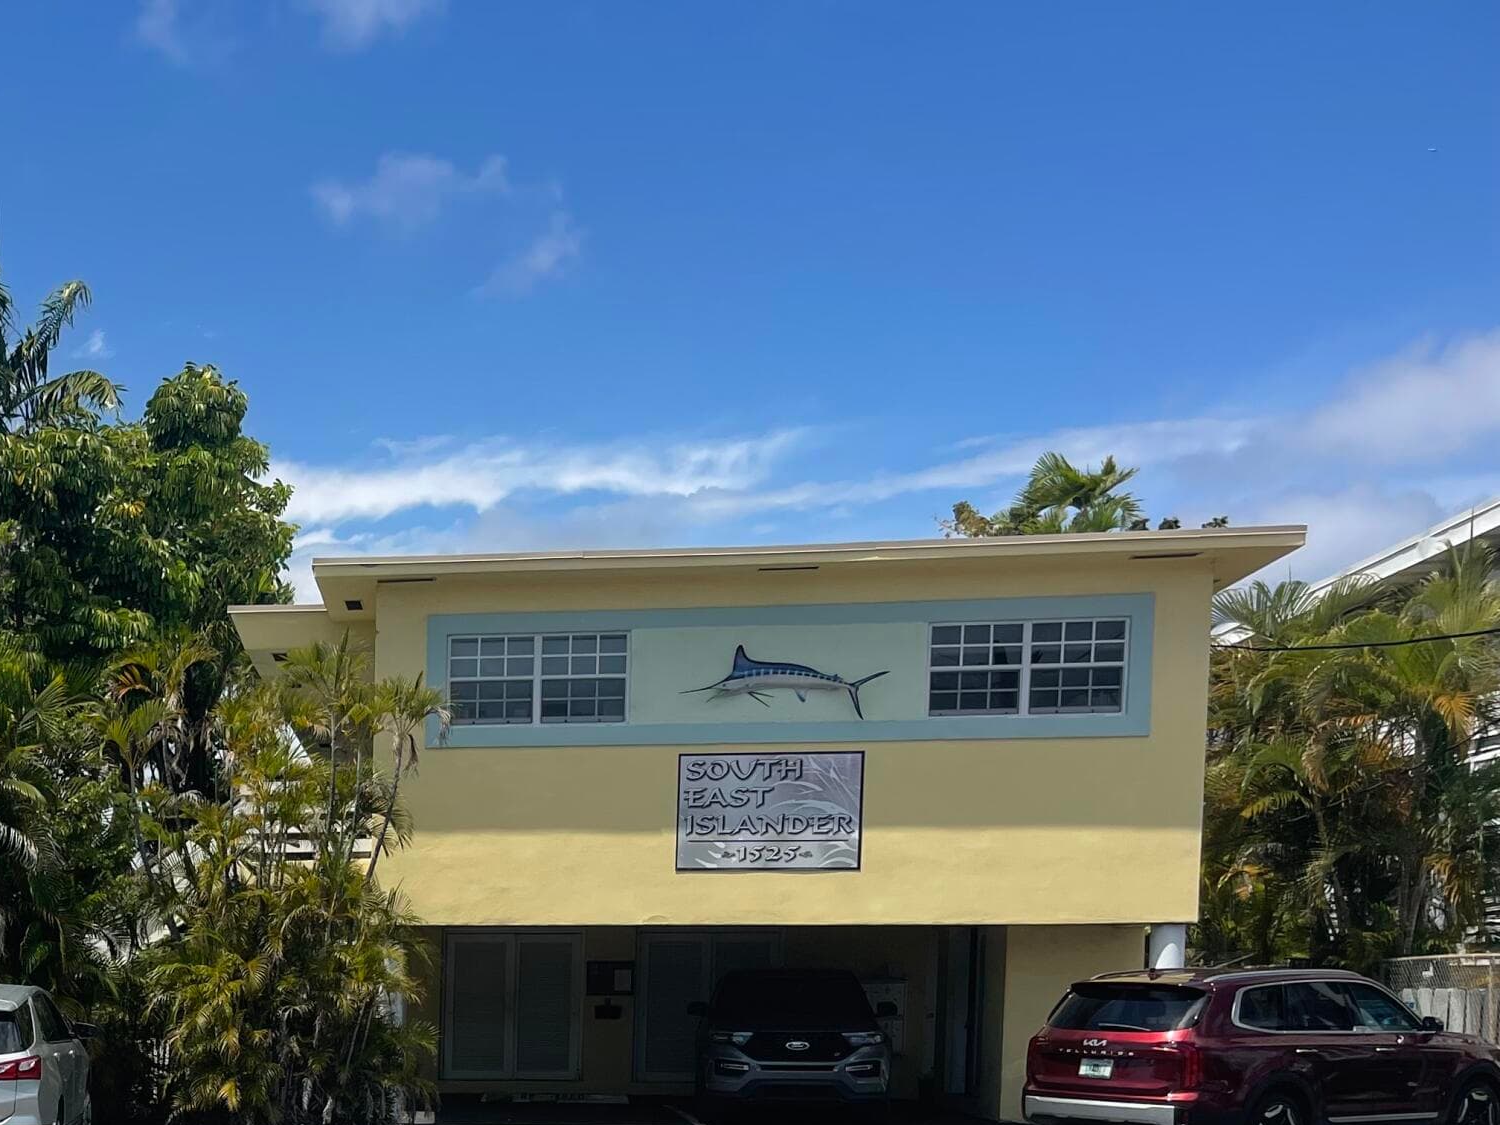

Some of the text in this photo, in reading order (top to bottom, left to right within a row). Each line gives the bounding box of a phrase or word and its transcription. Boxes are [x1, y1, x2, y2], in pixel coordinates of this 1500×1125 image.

[686, 759, 803, 782] SOUTH
[683, 786, 775, 809] EAST
[684, 813, 855, 837] ISLANDER
[737, 845, 802, 863] 1525
